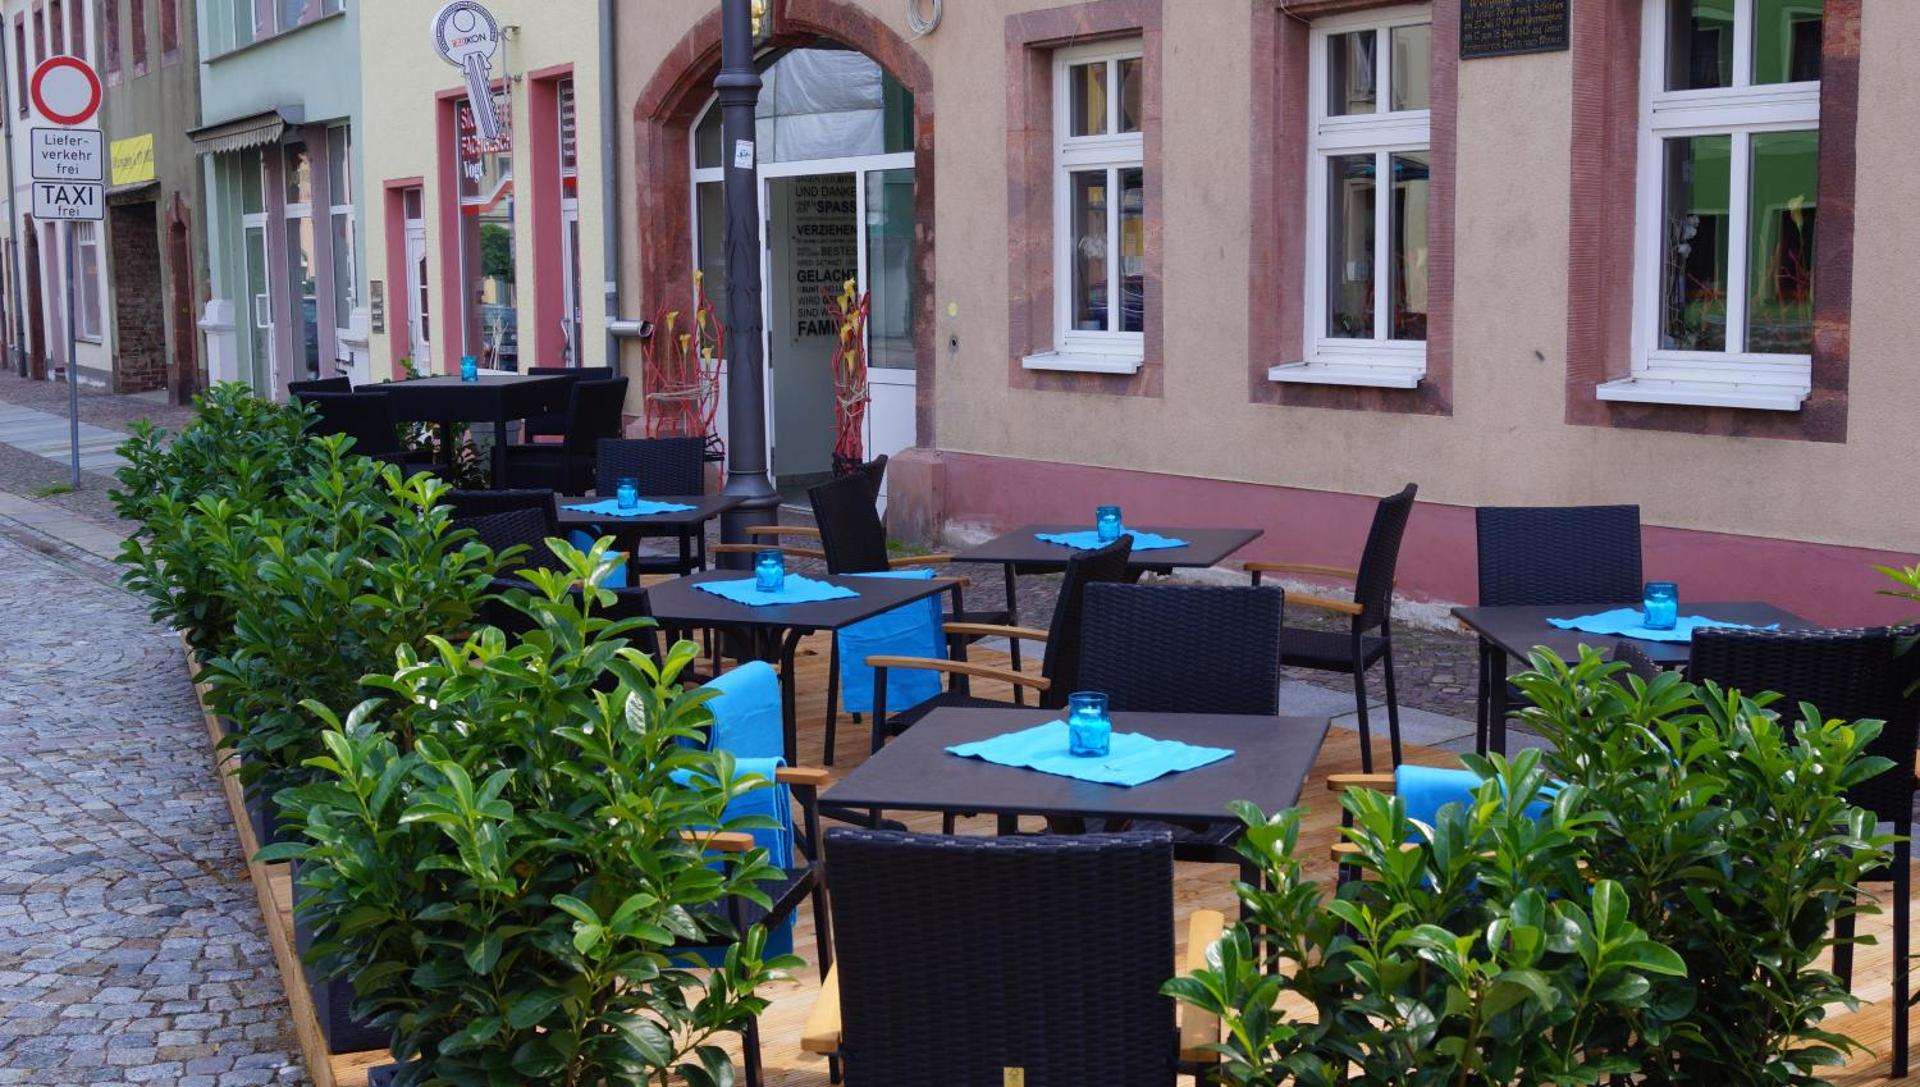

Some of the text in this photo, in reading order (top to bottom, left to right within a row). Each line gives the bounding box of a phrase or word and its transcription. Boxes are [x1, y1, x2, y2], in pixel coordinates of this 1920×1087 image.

[44, 134, 89, 146] Liefer-
[41, 149, 93, 161] verkehr
[56, 163, 79, 174] frei
[464, 159, 483, 183] Vogt
[41, 185, 93, 206] TAXI
[795, 186, 857, 197] UND DANKE
[58, 205, 80, 217] frei
[816, 201, 857, 213] SPASS
[796, 224, 857, 236] VERZIEHEN
[796, 269, 857, 283] GELACHT
[798, 308, 819, 318] SIND
[798, 321, 840, 337] FAMI
